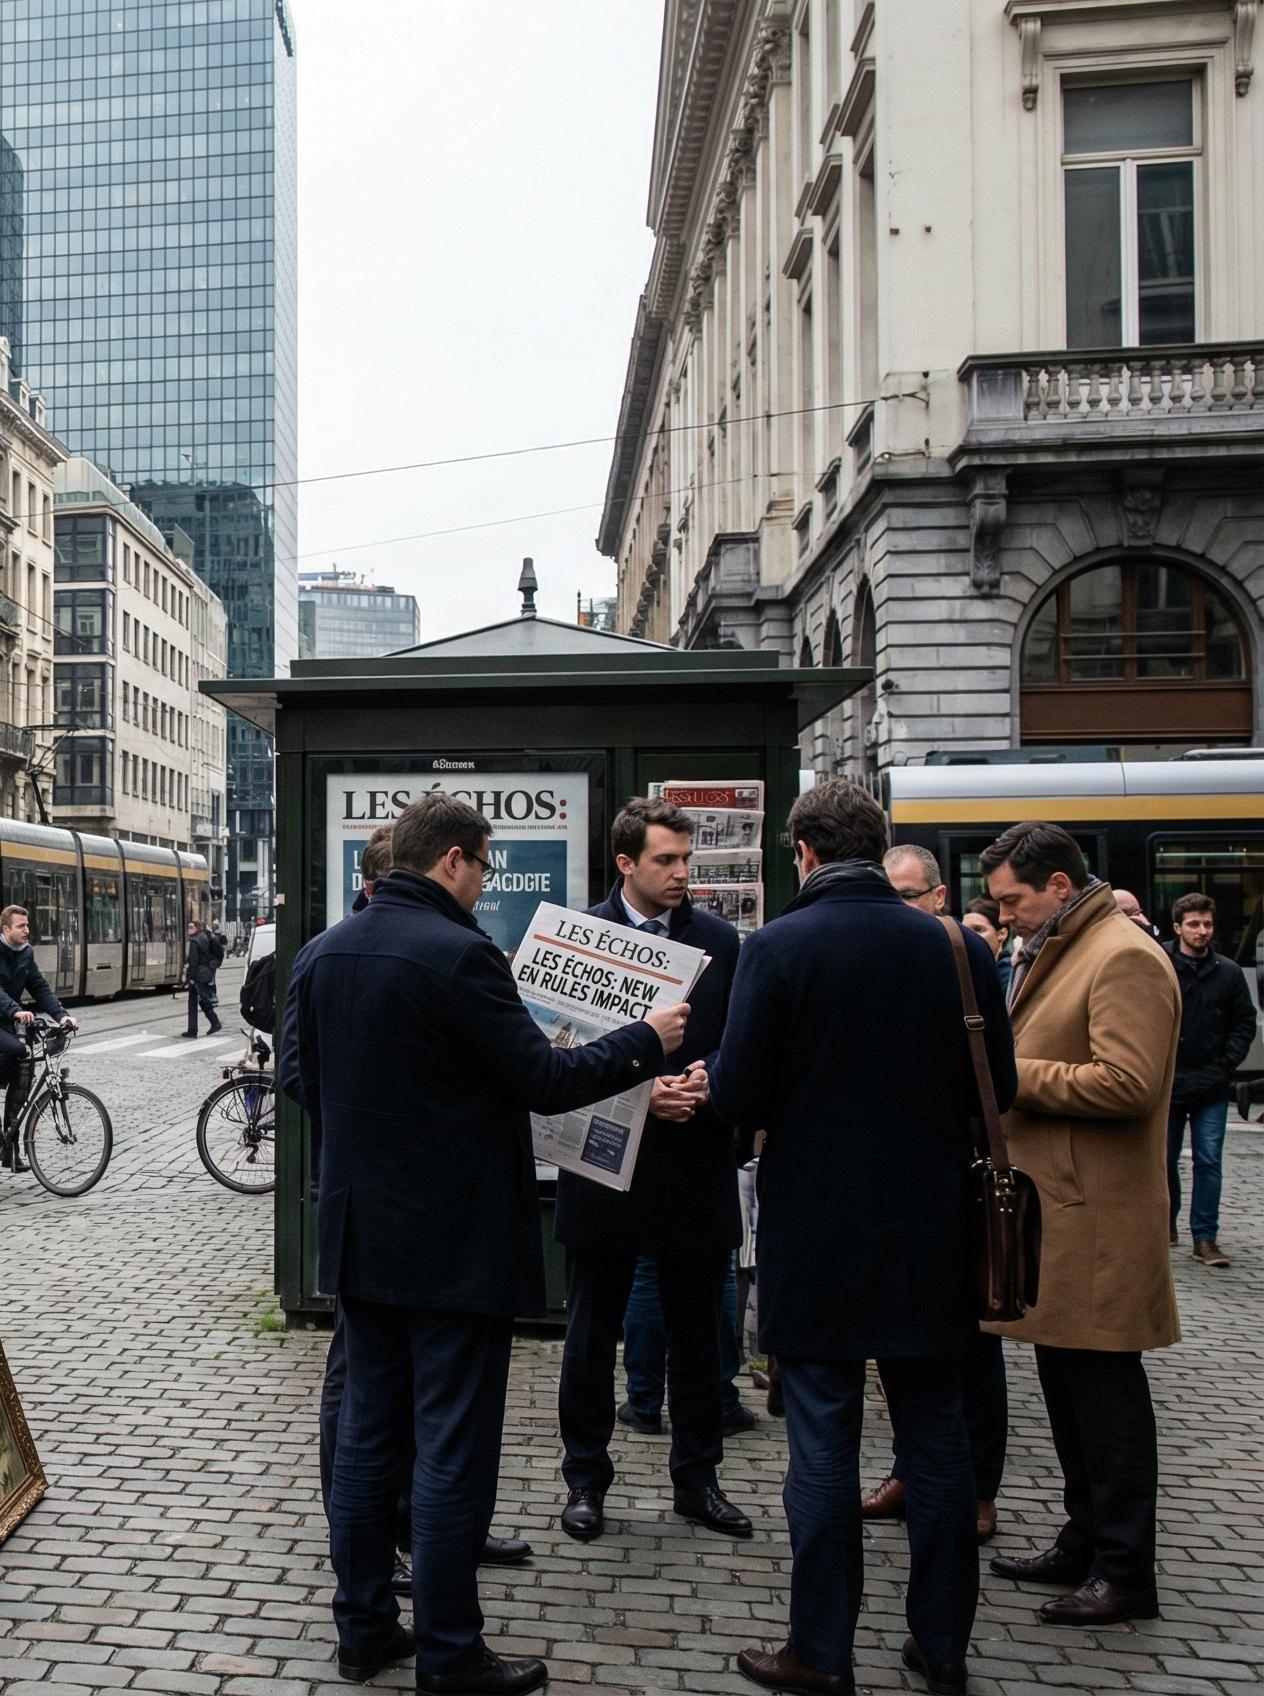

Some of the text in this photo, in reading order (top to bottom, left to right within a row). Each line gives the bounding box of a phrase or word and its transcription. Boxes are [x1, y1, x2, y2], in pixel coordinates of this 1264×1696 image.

[342, 790, 411, 820] LES
[554, 920, 671, 970] LES ÉCHOS:
[517, 964, 539, 986] EN
[540, 970, 591, 1001] RULES
[591, 988, 653, 1021] IMPACT
[531, 947, 660, 1003] LES ÉCHOS: NEW
